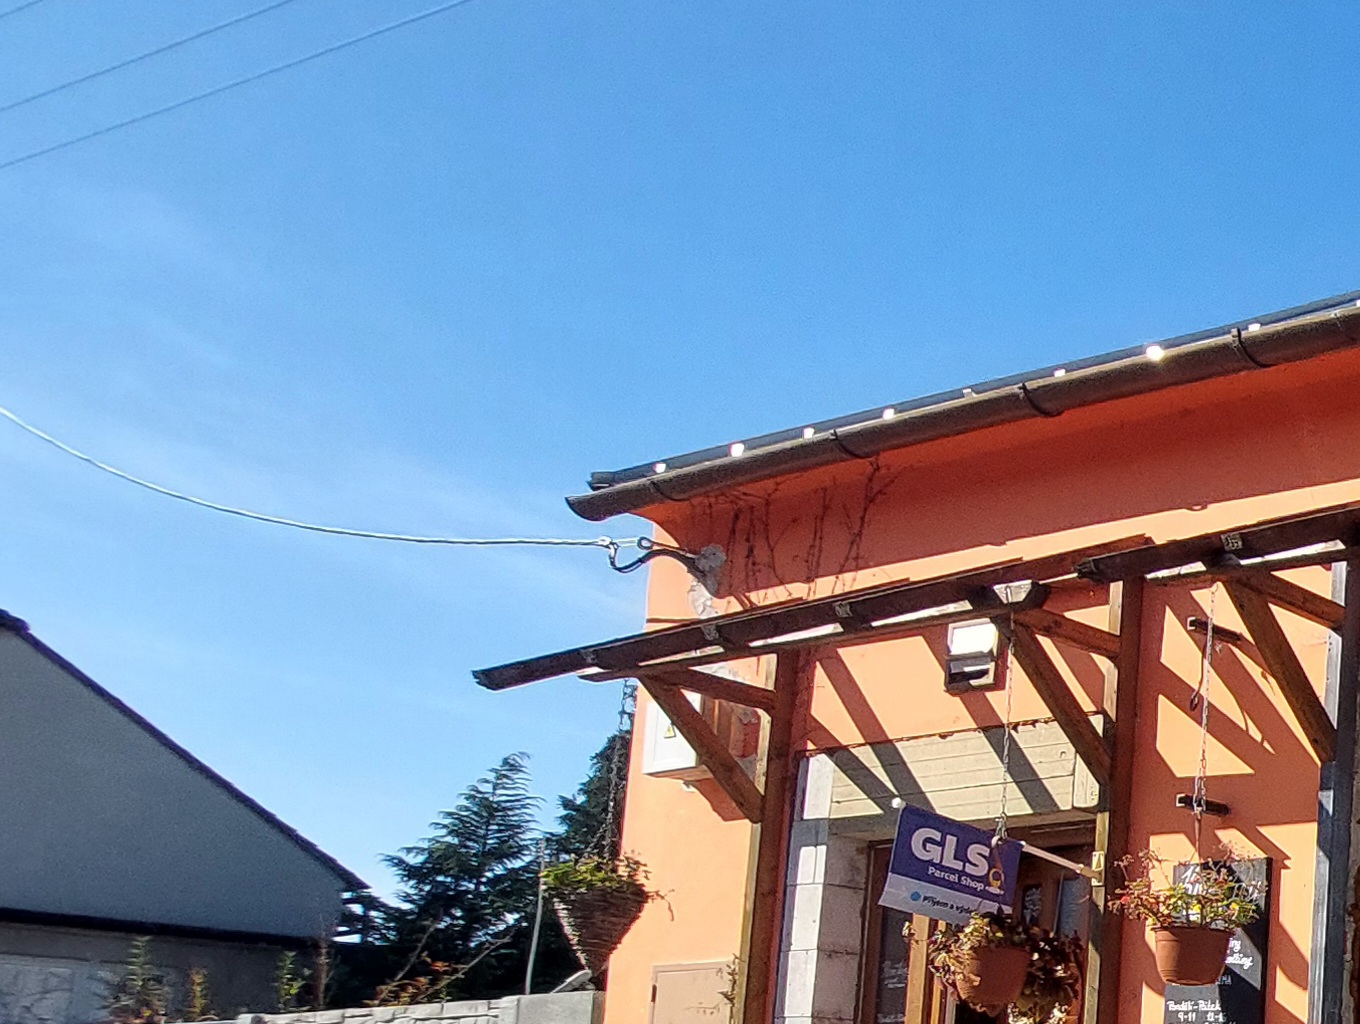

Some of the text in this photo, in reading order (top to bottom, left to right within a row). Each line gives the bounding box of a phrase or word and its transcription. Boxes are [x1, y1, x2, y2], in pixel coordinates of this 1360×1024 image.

[911, 827, 991, 877] GLS
[928, 866, 985, 892] Parcel Shop
